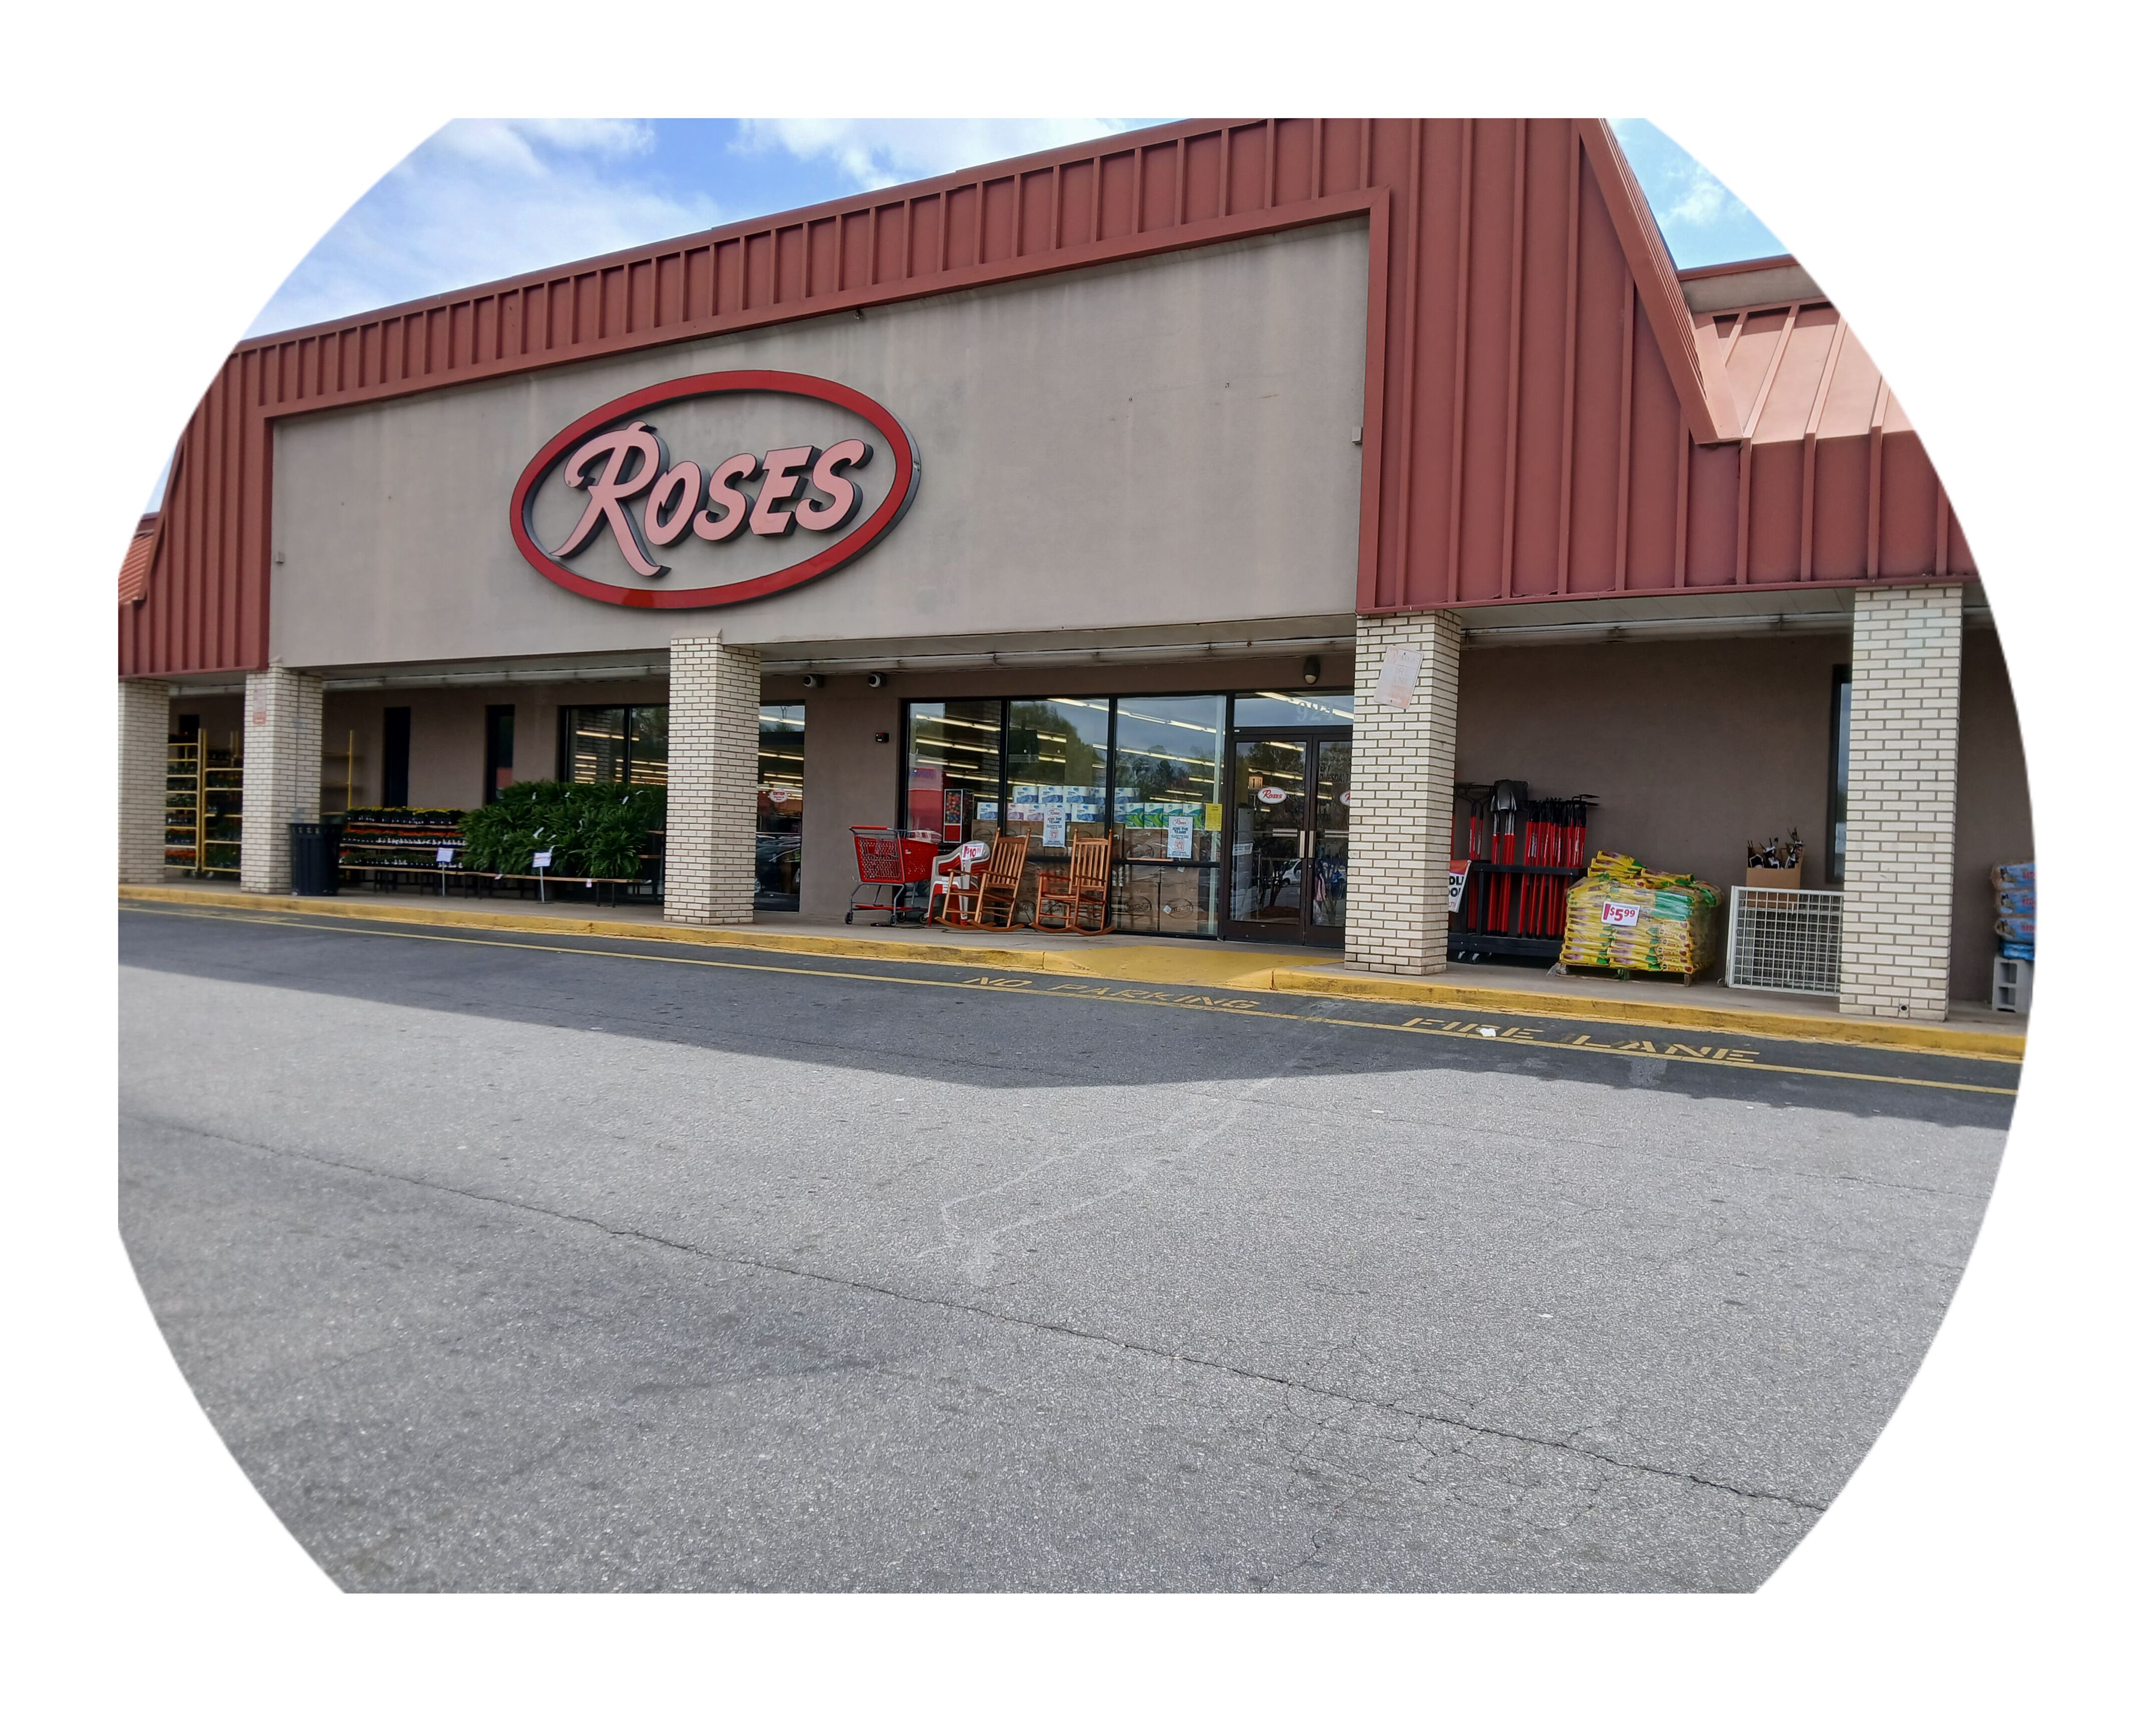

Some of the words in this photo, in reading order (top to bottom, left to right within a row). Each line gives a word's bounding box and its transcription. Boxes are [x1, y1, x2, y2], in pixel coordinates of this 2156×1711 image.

[962, 976, 1033, 988] NO
[1047, 983, 1260, 1009] PARKING
[1402, 1017, 1545, 1040] FIRE
[1572, 1035, 1760, 1062] LANE
